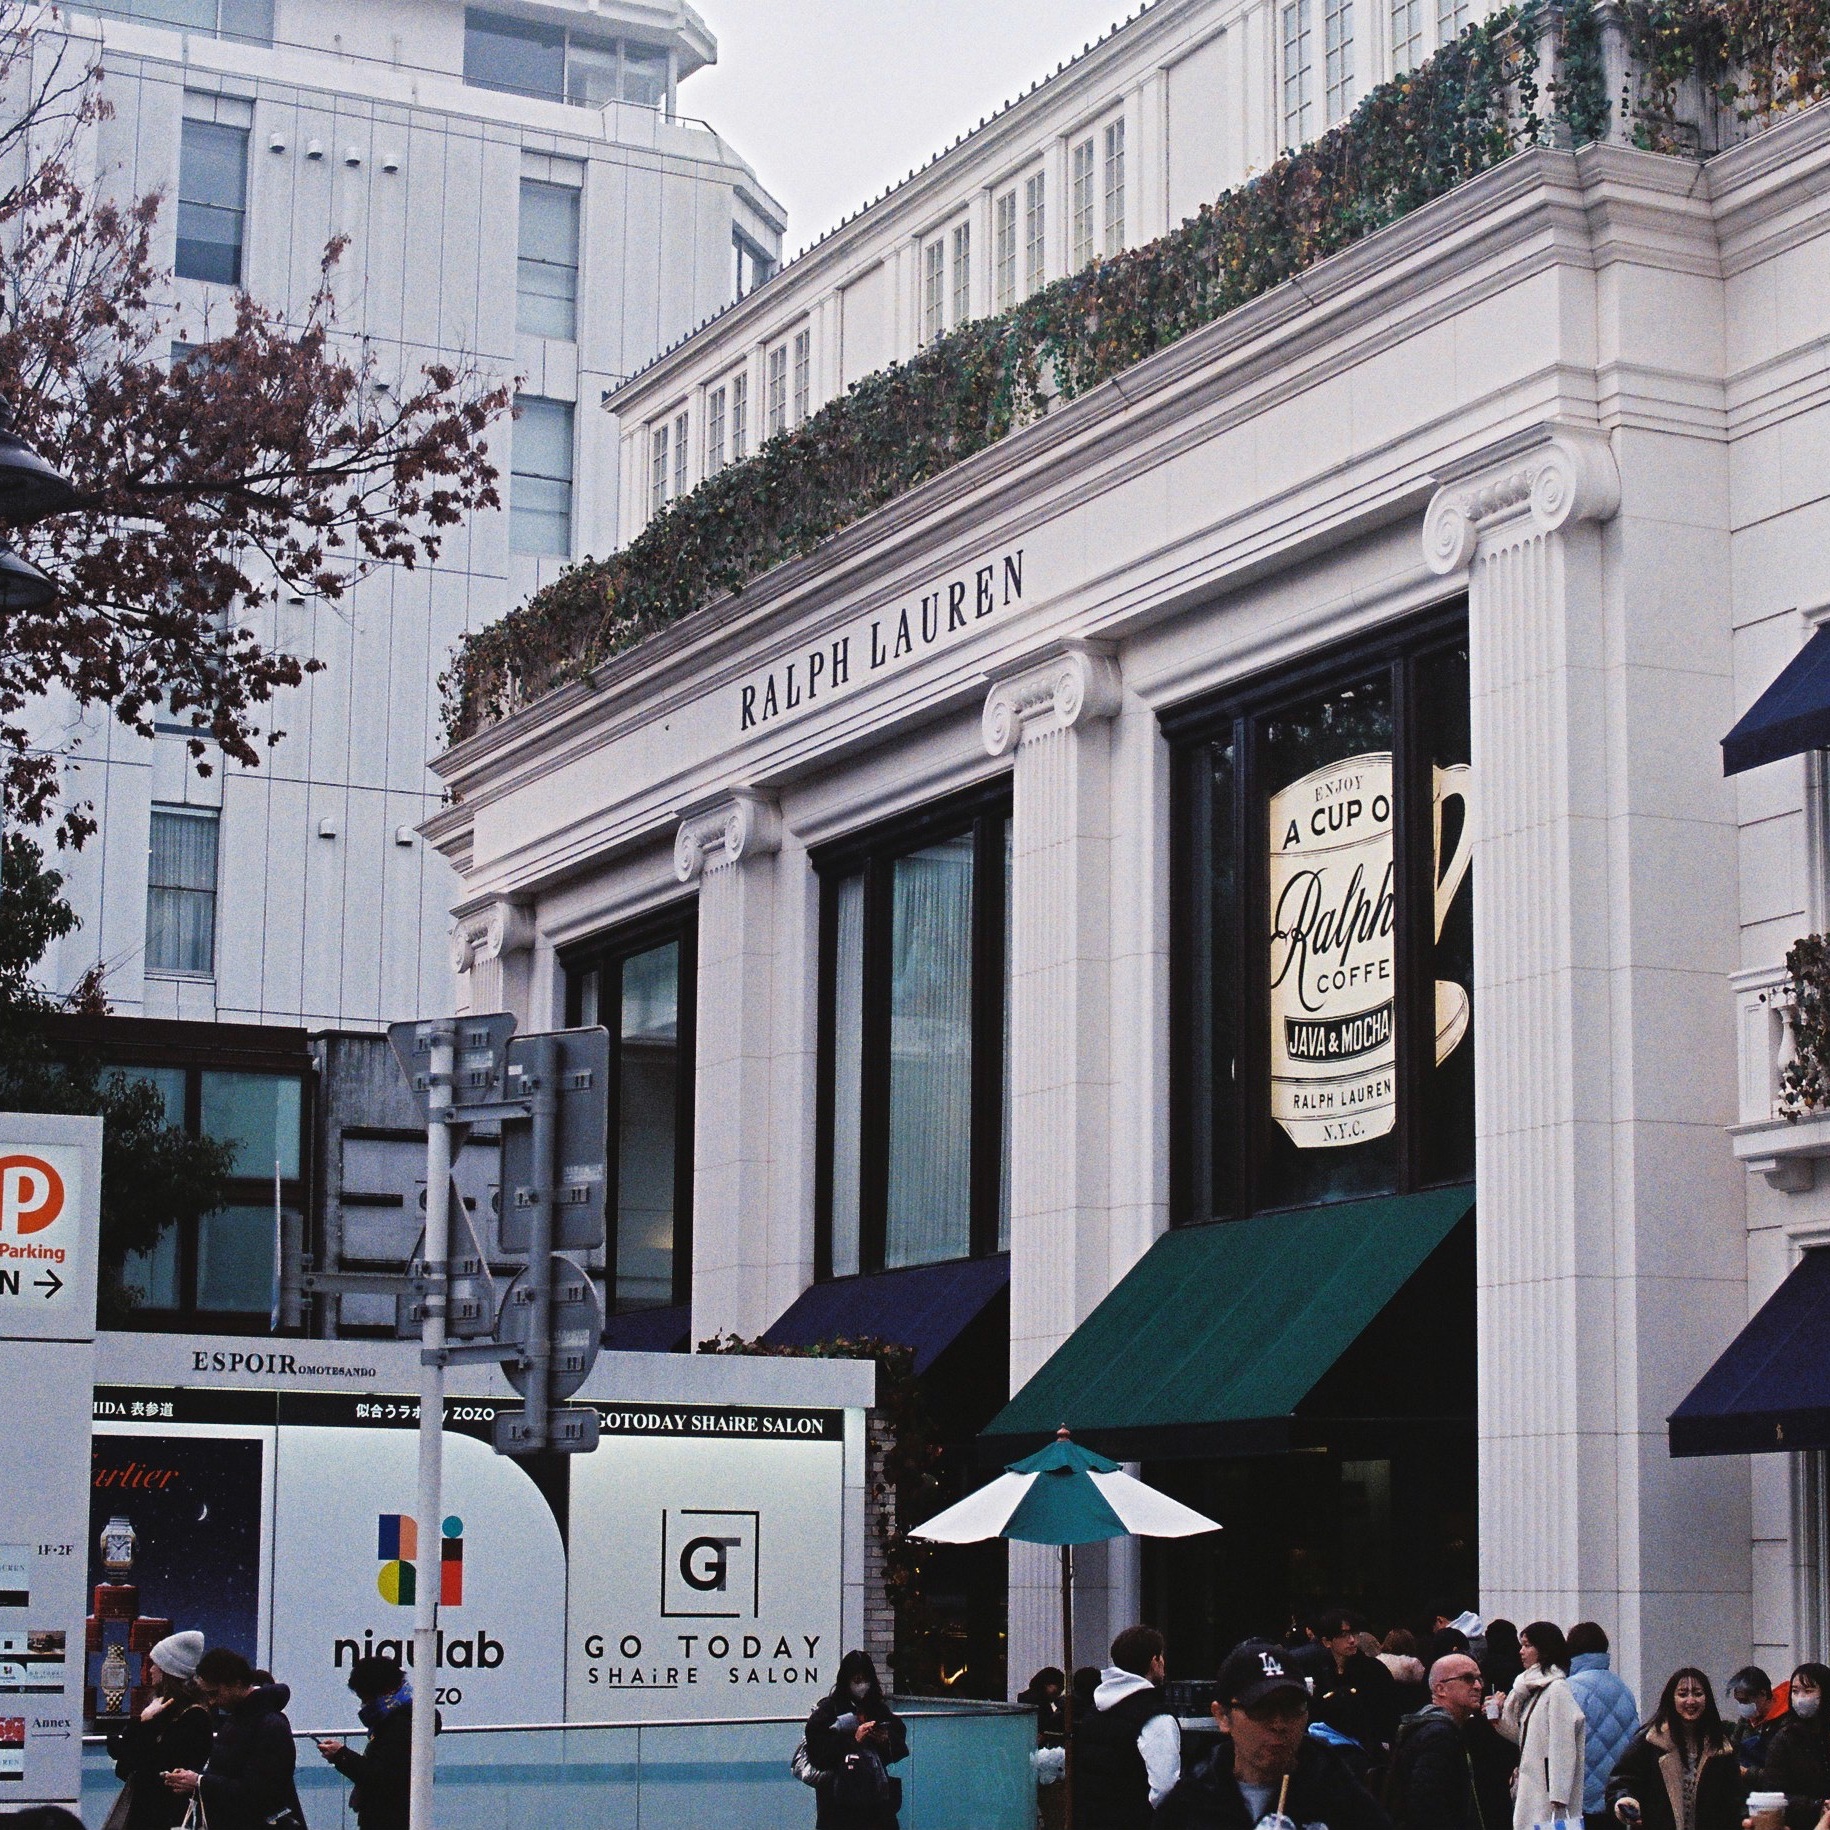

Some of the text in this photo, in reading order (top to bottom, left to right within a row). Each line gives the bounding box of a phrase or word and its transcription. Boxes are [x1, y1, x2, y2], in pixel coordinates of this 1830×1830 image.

[741, 549, 1023, 731] RALPH LAUREN
[1315, 776, 1363, 802] ENJOY
[1282, 794, 1392, 851] A CUP O
[1270, 861, 1394, 1010] Ralph
[1289, 1009, 1390, 1056] JAVA & MOCHA
[1293, 1078, 1391, 1109] RALPH LAUREN
[1323, 1120, 1365, 1142] N.Y.C.
[192, 1351, 377, 1377] ESPOIR OMOTESANDO
[131, 1401, 174, 1417] 表参道
[453, 1407, 495, 1421] ZOZO
[598, 1412, 824, 1434] GOTODAY SHAiRE SALON
[92, 1454, 179, 1488] artier
[584, 1634, 821, 1659] GO TODAY
[588, 1667, 818, 1685] SHAiRE SALON
[1258, 1652, 1284, 1677] LA
[33, 1718, 71, 1728] Annex
